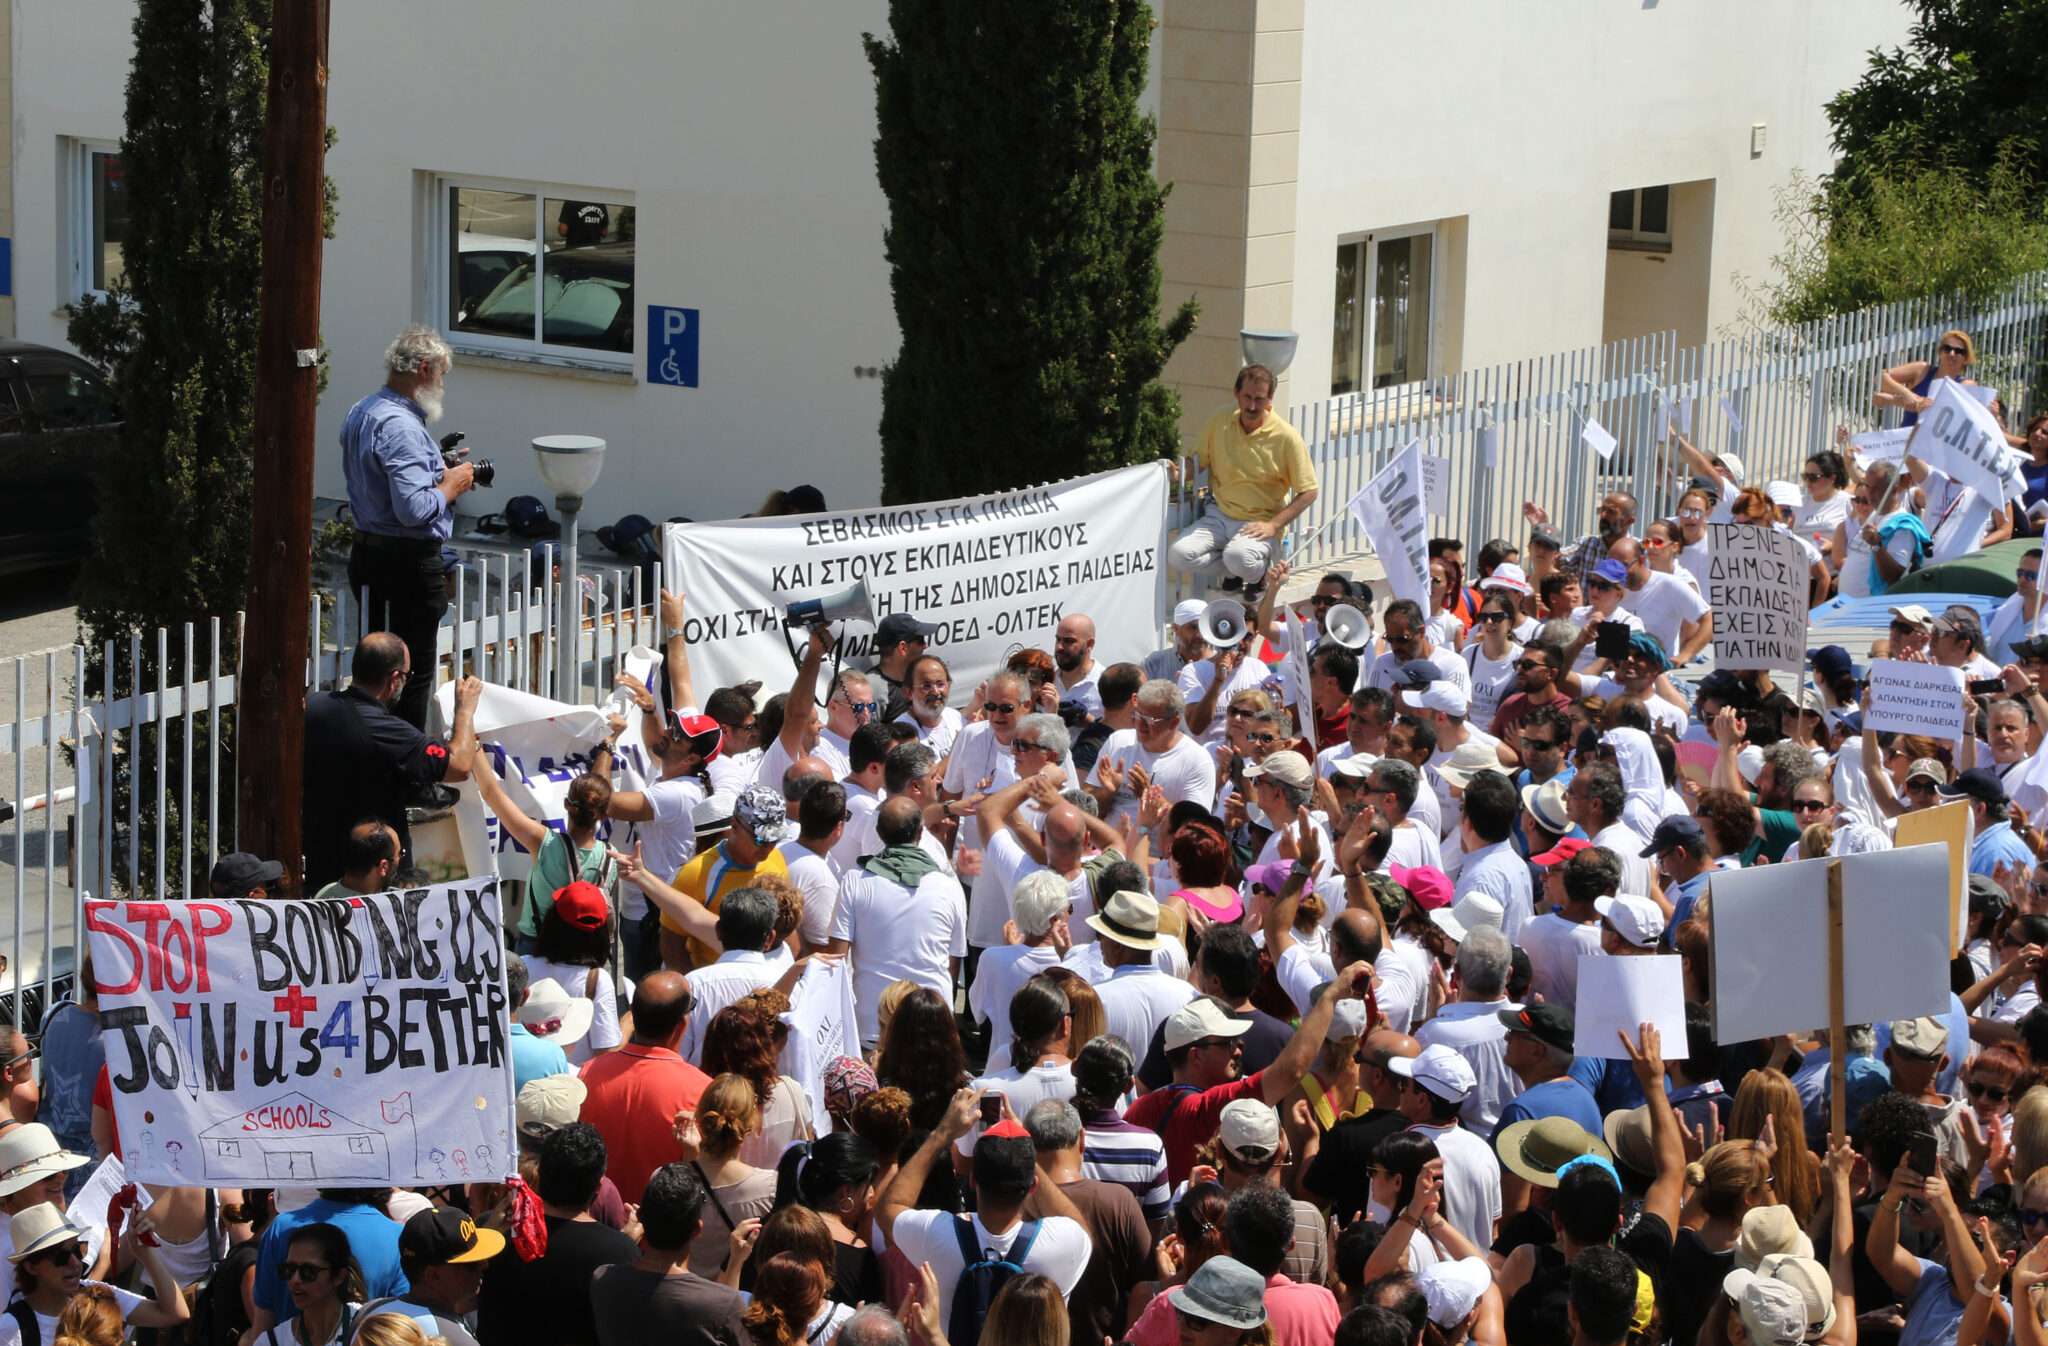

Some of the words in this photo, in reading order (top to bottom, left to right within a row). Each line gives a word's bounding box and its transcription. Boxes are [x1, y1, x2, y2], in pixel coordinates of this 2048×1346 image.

[664, 309, 686, 345] P
[802, 508, 928, 546] ΣΕΒΑΣΜΟΣ
[937, 503, 977, 529] ΣΤΑ
[983, 490, 1060, 521] ΠΑΙΔΙΑ
[1708, 523, 1782, 555] ΤΡΩΝΕ
[772, 561, 812, 592] ΚΑΙ
[820, 548, 898, 585] ΣΤΟΥΣ
[905, 522, 1089, 574] ΕΚΠΑΙΔΕΥΤΙΚΟΥΣ
[683, 613, 727, 645] ΟΧΙ
[900, 583, 943, 613] ΤΗΣ
[951, 564, 1061, 604] ΔΗΜΟΣΙΑΣ
[1067, 547, 1155, 587] ΠΑΙΔΕΙΑΣ
[1712, 611, 1777, 635] ΕΧΕΙΣ
[1714, 640, 1744, 658] ΓΙΑ
[1744, 639, 1781, 658] ΤΗΝ
[1873, 677, 1911, 689] ΑΓΩΝΑΣ
[1913, 681, 1963, 694] ΔΙΑΡΚΕΙΑΣ
[1877, 694, 1928, 707] ΑΠΑΝΤΗΣΗ
[1930, 700, 1956, 710] ΣΤΟΝ
[1869, 710, 1914, 722] ΥΠΟΥΡΓΟ
[1916, 715, 1960, 728] ΠΑΙΔΕΙΑΣ
[85, 901, 233, 994] STOP
[448, 882, 500, 984] US
[319, 1001, 360, 1058] 4
[365, 983, 507, 1074] BETTER
[242, 1106, 332, 1131] SCHOOLS
